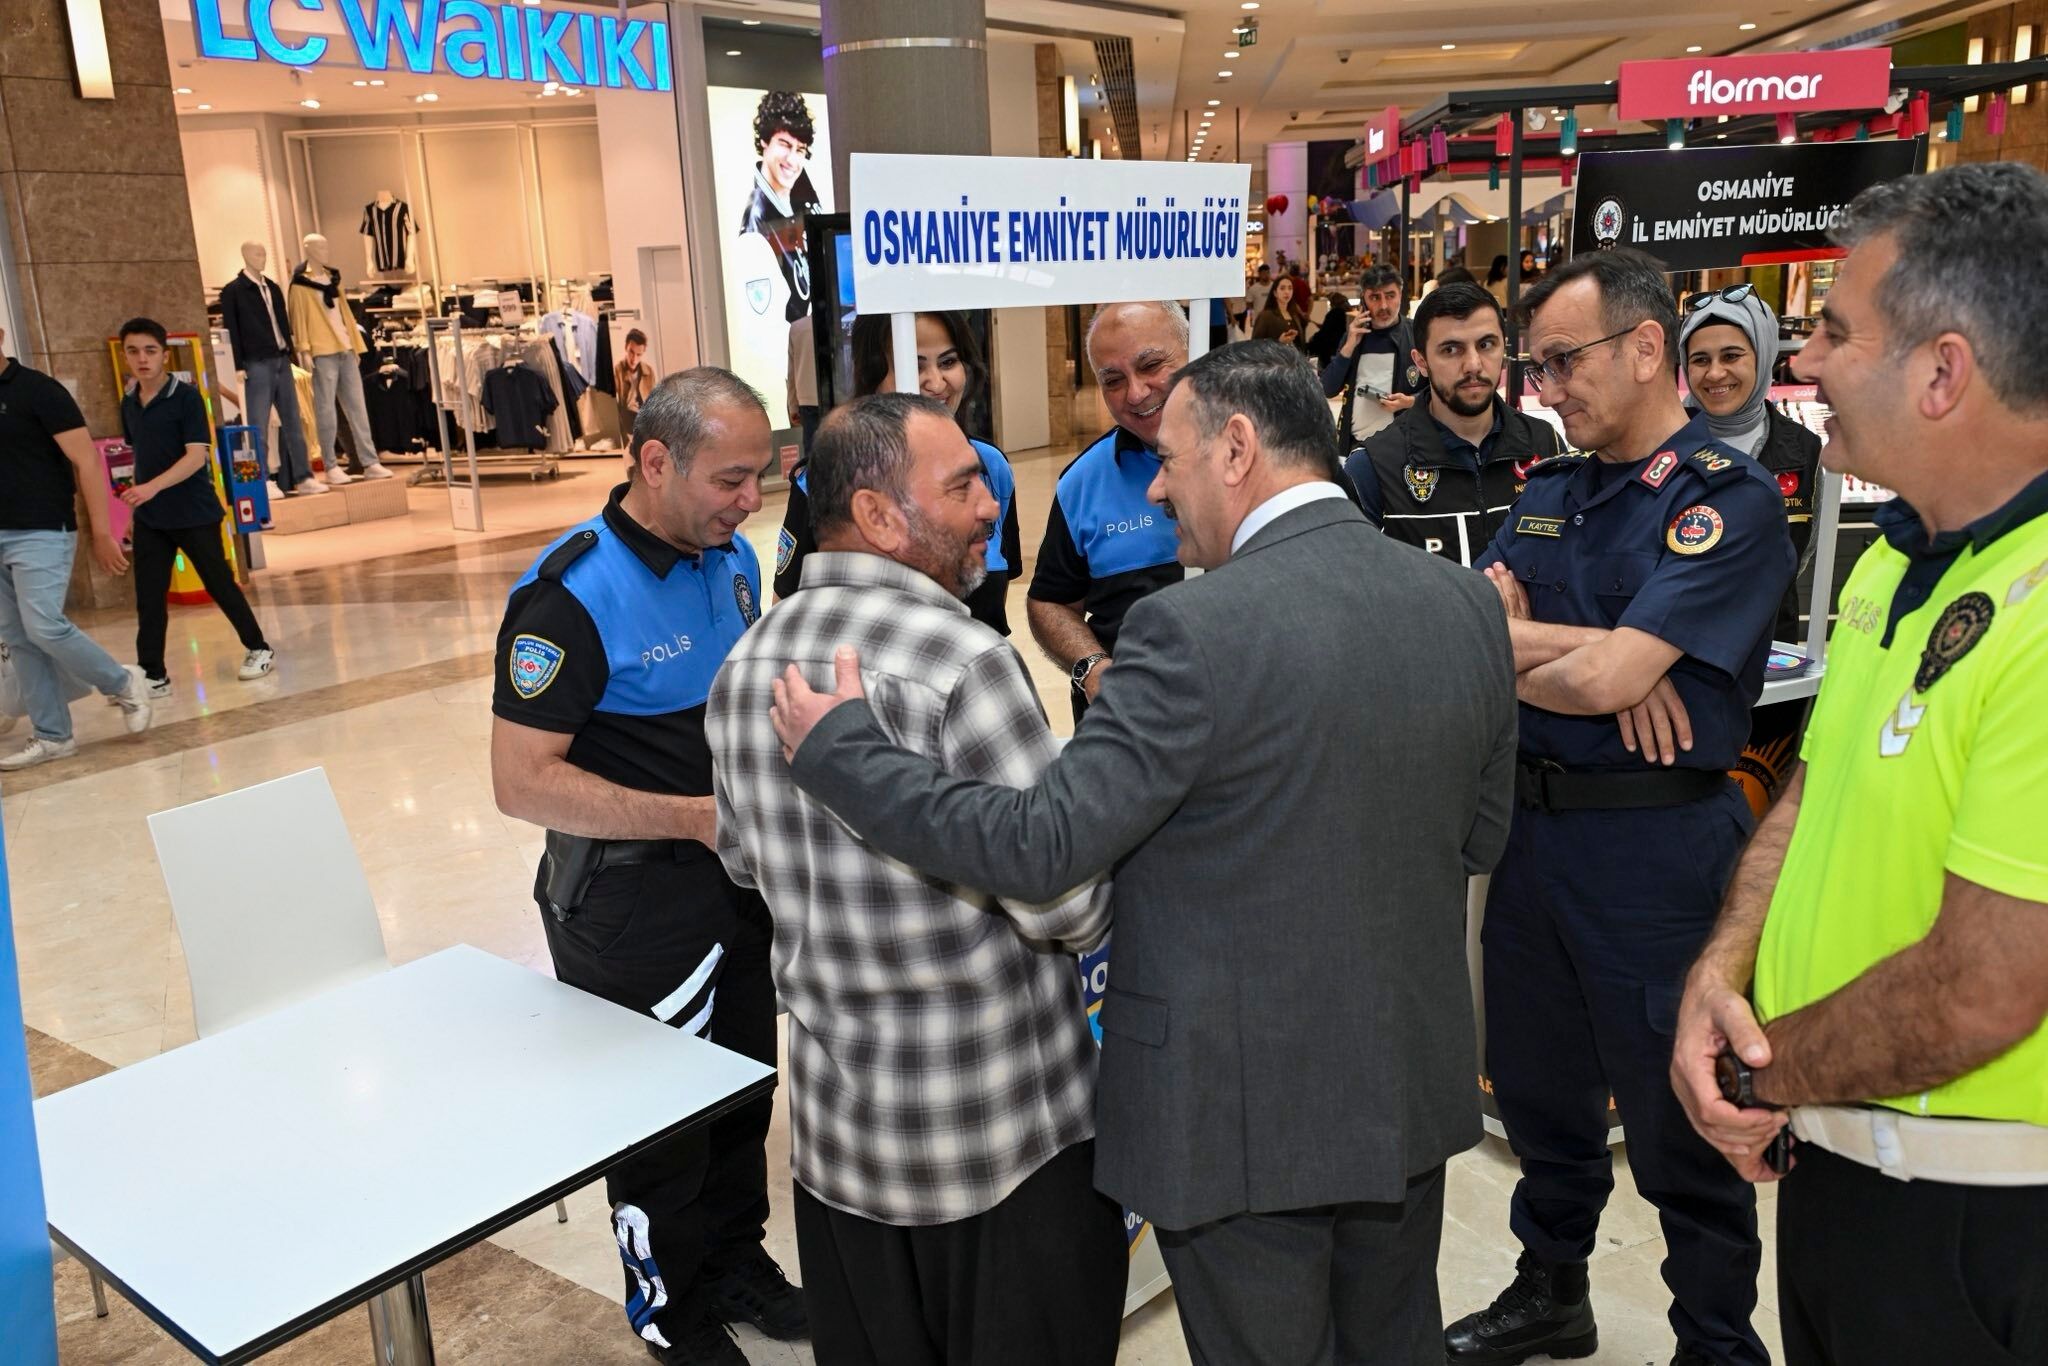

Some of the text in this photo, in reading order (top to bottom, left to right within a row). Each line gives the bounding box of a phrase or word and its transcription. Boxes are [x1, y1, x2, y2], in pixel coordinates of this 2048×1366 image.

[198, 0, 328, 66] LC
[1687, 69, 1822, 104] flormar
[1697, 171, 1795, 202] OSMANİYE
[864, 195, 1240, 265] OSMANİYE EMNİYET MÜDÜRLÜĞÜ
[1631, 215, 1649, 243] İL
[1653, 212, 1735, 241] EMNİYET
[1106, 513, 1154, 537] POLİS
[1528, 521, 1560, 533] KAYTEZ
[1839, 597, 1882, 635] OLİS
[642, 633, 693, 670] POLİS
